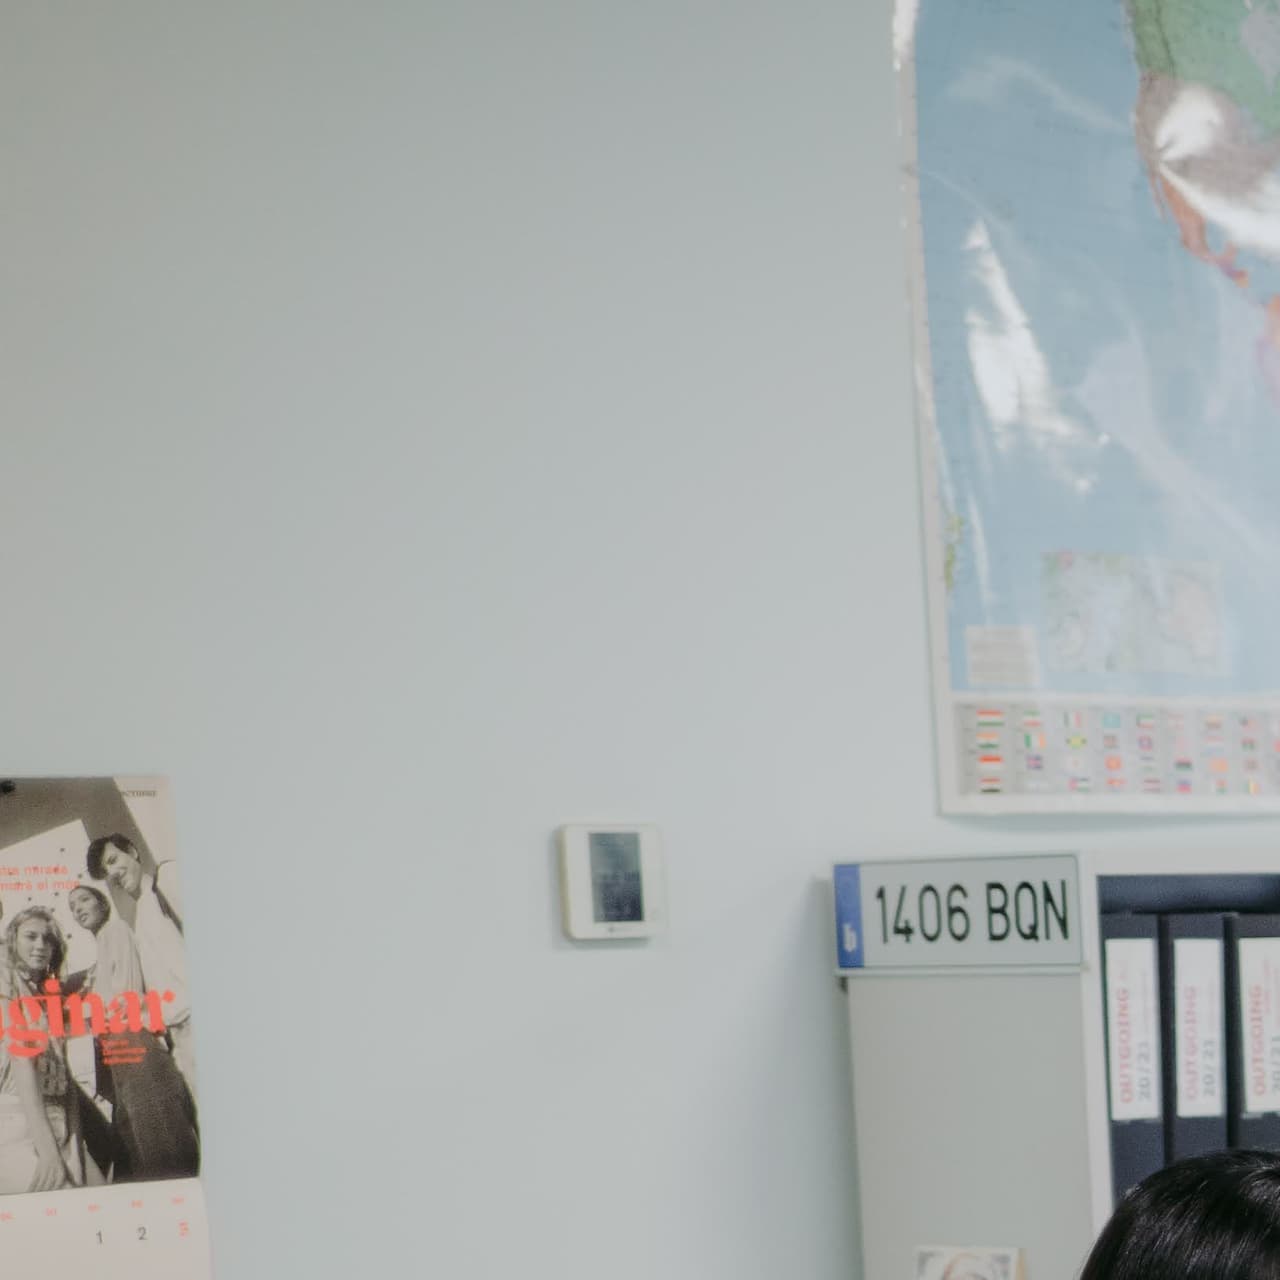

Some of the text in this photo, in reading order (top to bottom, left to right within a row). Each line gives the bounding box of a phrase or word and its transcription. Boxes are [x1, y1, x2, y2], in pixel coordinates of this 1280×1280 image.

[875, 884, 970, 944] 1406
[986, 879, 1069, 942] BQN
[0, 978, 176, 1059] ginar
[1117, 987, 1133, 1104] OUTGOING
[1184, 985, 1198, 1099] OUTGOING
[1249, 984, 1266, 1096] OUTGOING
[96, 1230, 104, 1244] 1
[137, 1226, 147, 1241] 2
